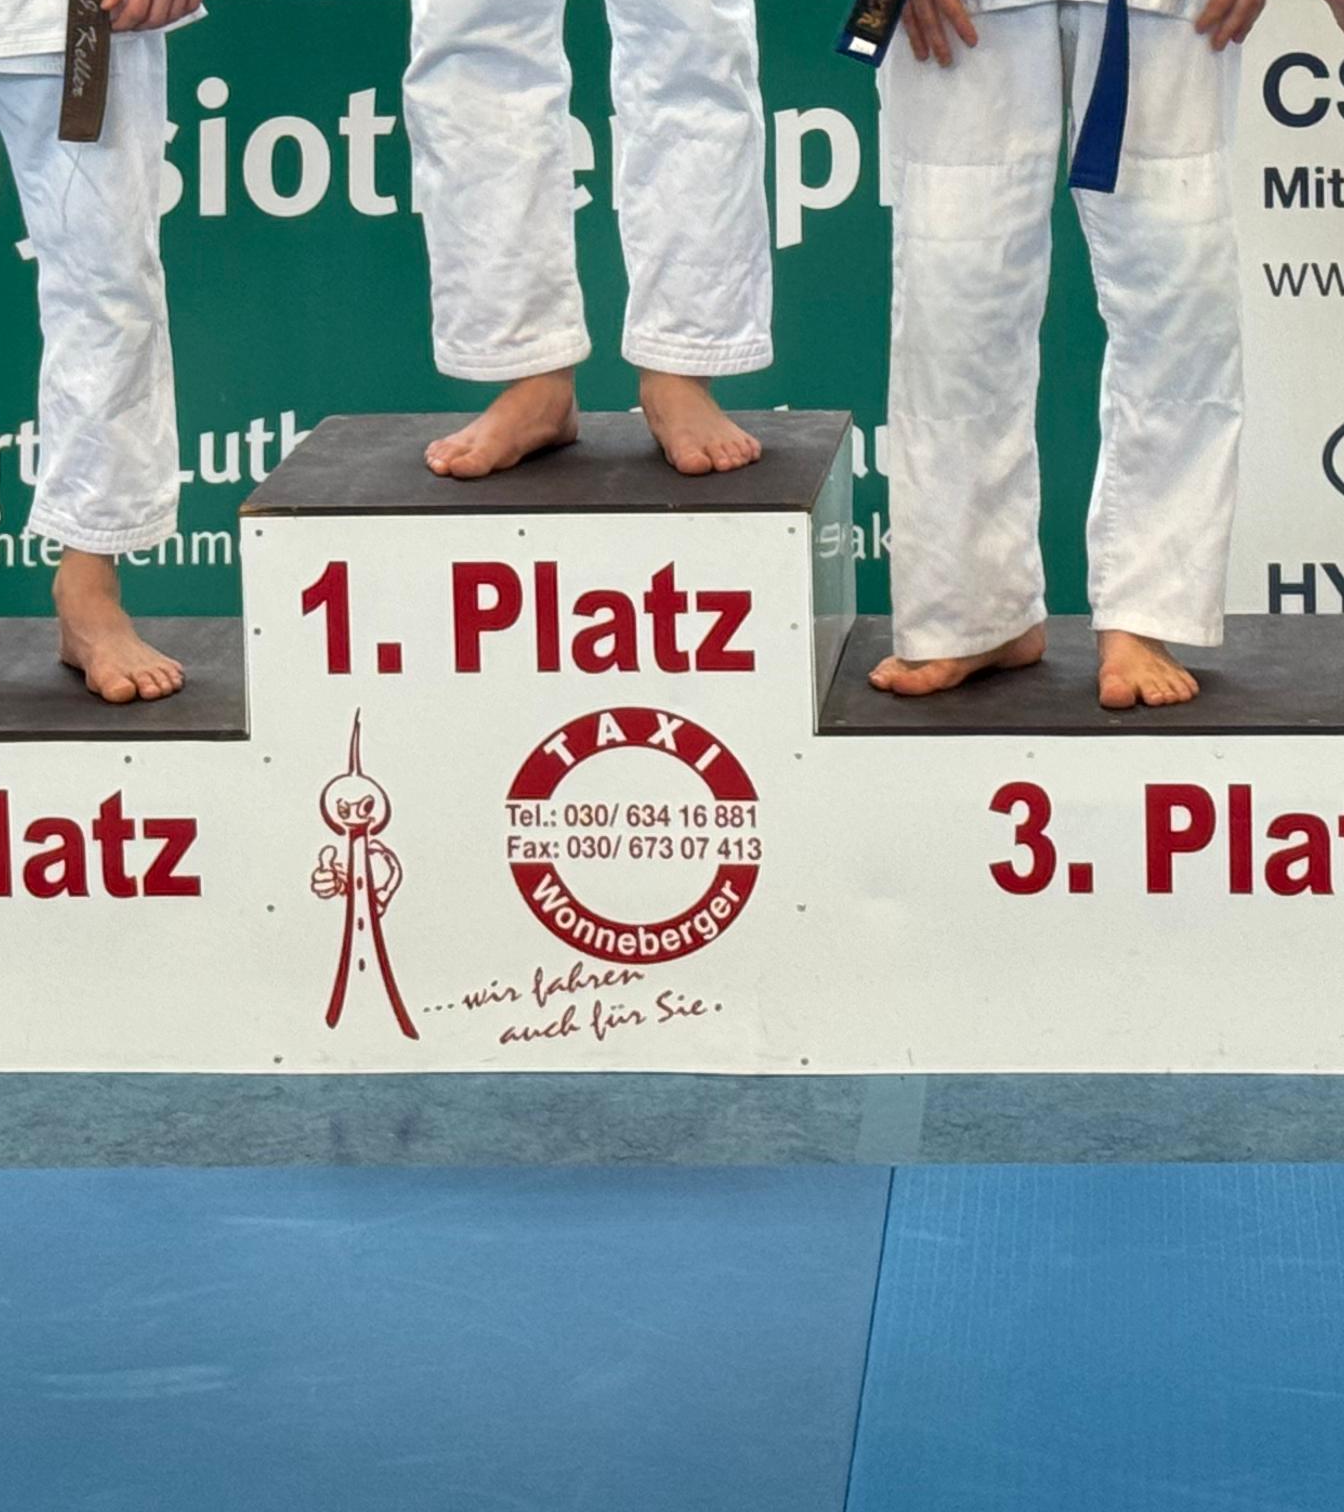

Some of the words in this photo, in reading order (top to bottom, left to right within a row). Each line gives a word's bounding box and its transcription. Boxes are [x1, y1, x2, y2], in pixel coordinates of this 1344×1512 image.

[301, 561, 403, 675] 1.
[452, 560, 757, 675] Platz
[542, 711, 723, 773] TAXI
[505, 803, 558, 828] Tel.:
[563, 803, 620, 829] 030/
[625, 804, 672, 828] 634
[679, 804, 708, 828] 16
[714, 804, 758, 829] 881
[988, 781, 1094, 896] 3.
[507, 835, 560, 860] Fax:
[566, 835, 622, 861] 030/
[628, 836, 674, 861] 673
[680, 837, 710, 861] 07
[717, 837, 763, 862] 413
[531, 872, 741, 957] Wonneberger
[531, 961, 645, 1008] fahren
[499, 1004, 581, 1045] auch
[590, 999, 648, 1042] für
